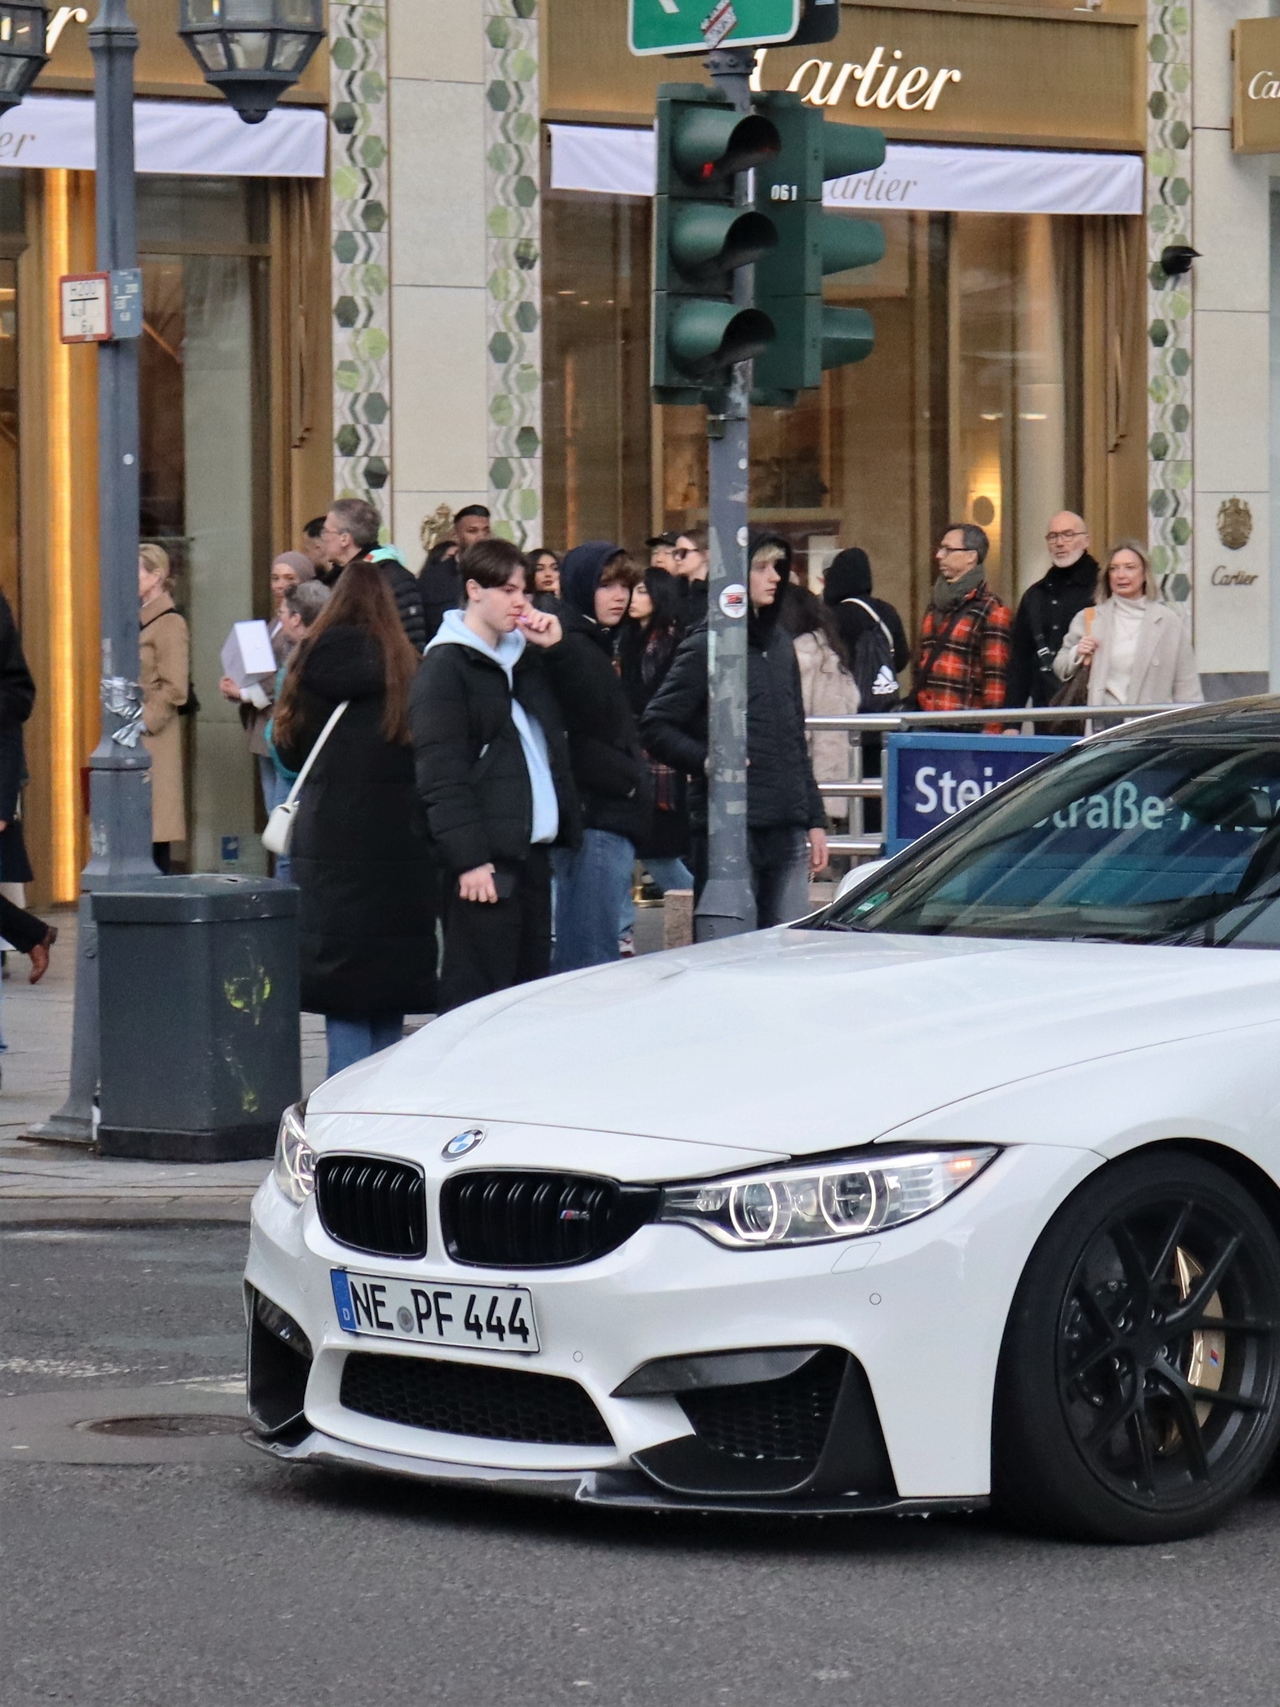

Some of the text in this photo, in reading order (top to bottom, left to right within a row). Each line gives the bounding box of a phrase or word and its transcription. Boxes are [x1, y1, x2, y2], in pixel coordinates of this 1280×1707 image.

[770, 184, 798, 201] 061
[823, 168, 917, 202] artier
[1211, 564, 1260, 586] Cartier
[350, 1281, 530, 1344] NE PF 444
